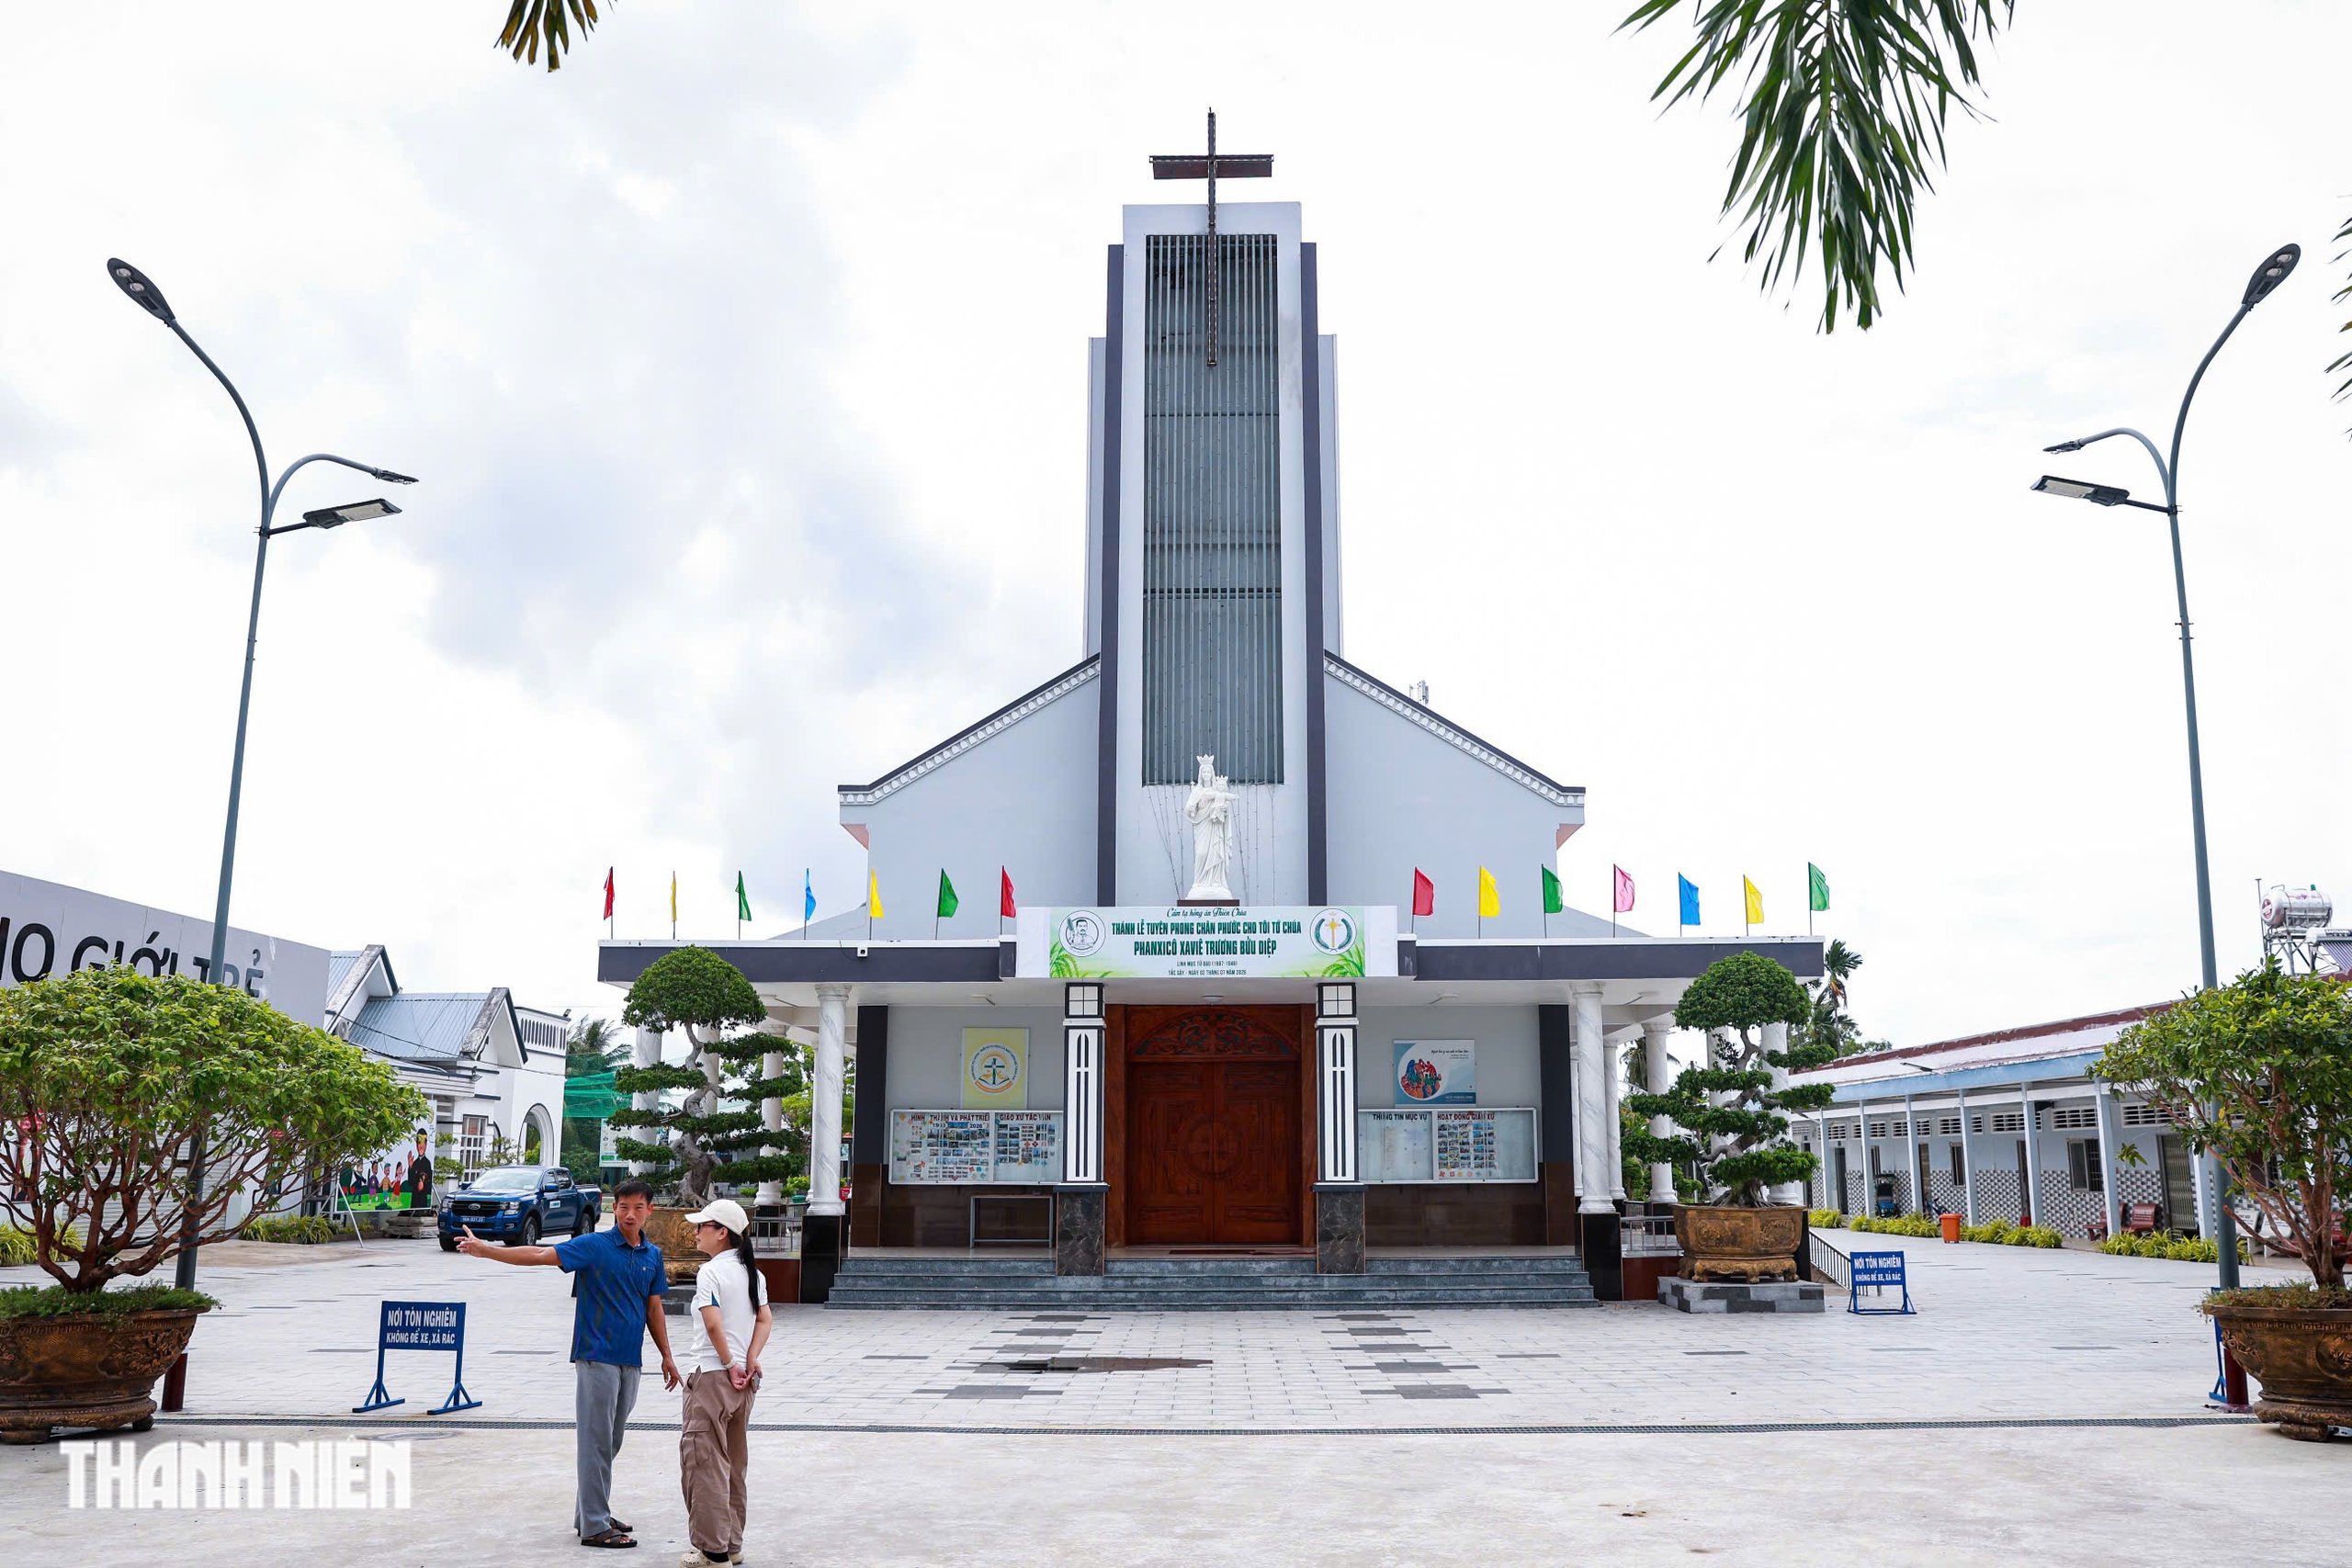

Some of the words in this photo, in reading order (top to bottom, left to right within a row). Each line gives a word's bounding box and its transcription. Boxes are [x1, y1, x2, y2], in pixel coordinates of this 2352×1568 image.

[1112, 920, 1135, 935] THÁNH
[1136, 919, 1145, 935] LỄ
[1147, 920, 1168, 935] TUYÊN
[1170, 921, 1194, 935] PHONG
[1196, 920, 1216, 934] CHÂN
[1217, 919, 1240, 934] PHƯỚC
[1243, 921, 1257, 934] CHO
[1259, 919, 1270, 934] TÔI
[1283, 919, 1302, 934] CHÚA
[1134, 938, 1177, 956] PHANXICÔ
[1180, 938, 1203, 955] XAVIÊ
[1205, 939, 1238, 955] TRƯƠNG
[1239, 935, 1256, 955] BỬU
[1259, 937, 1277, 958] DIỆP
[1854, 1257, 1865, 1269] NƠI
[1878, 1254, 1902, 1269] NGHIÊM
[1855, 1272, 1871, 1282] KHÔNG
[387, 1307, 403, 1327] NƠI
[423, 1306, 457, 1327] NGHIÊM
[386, 1329, 409, 1344] KHÔNG
[410, 1327, 420, 1344] ĐỂ
[442, 1330, 456, 1344] RÁC
